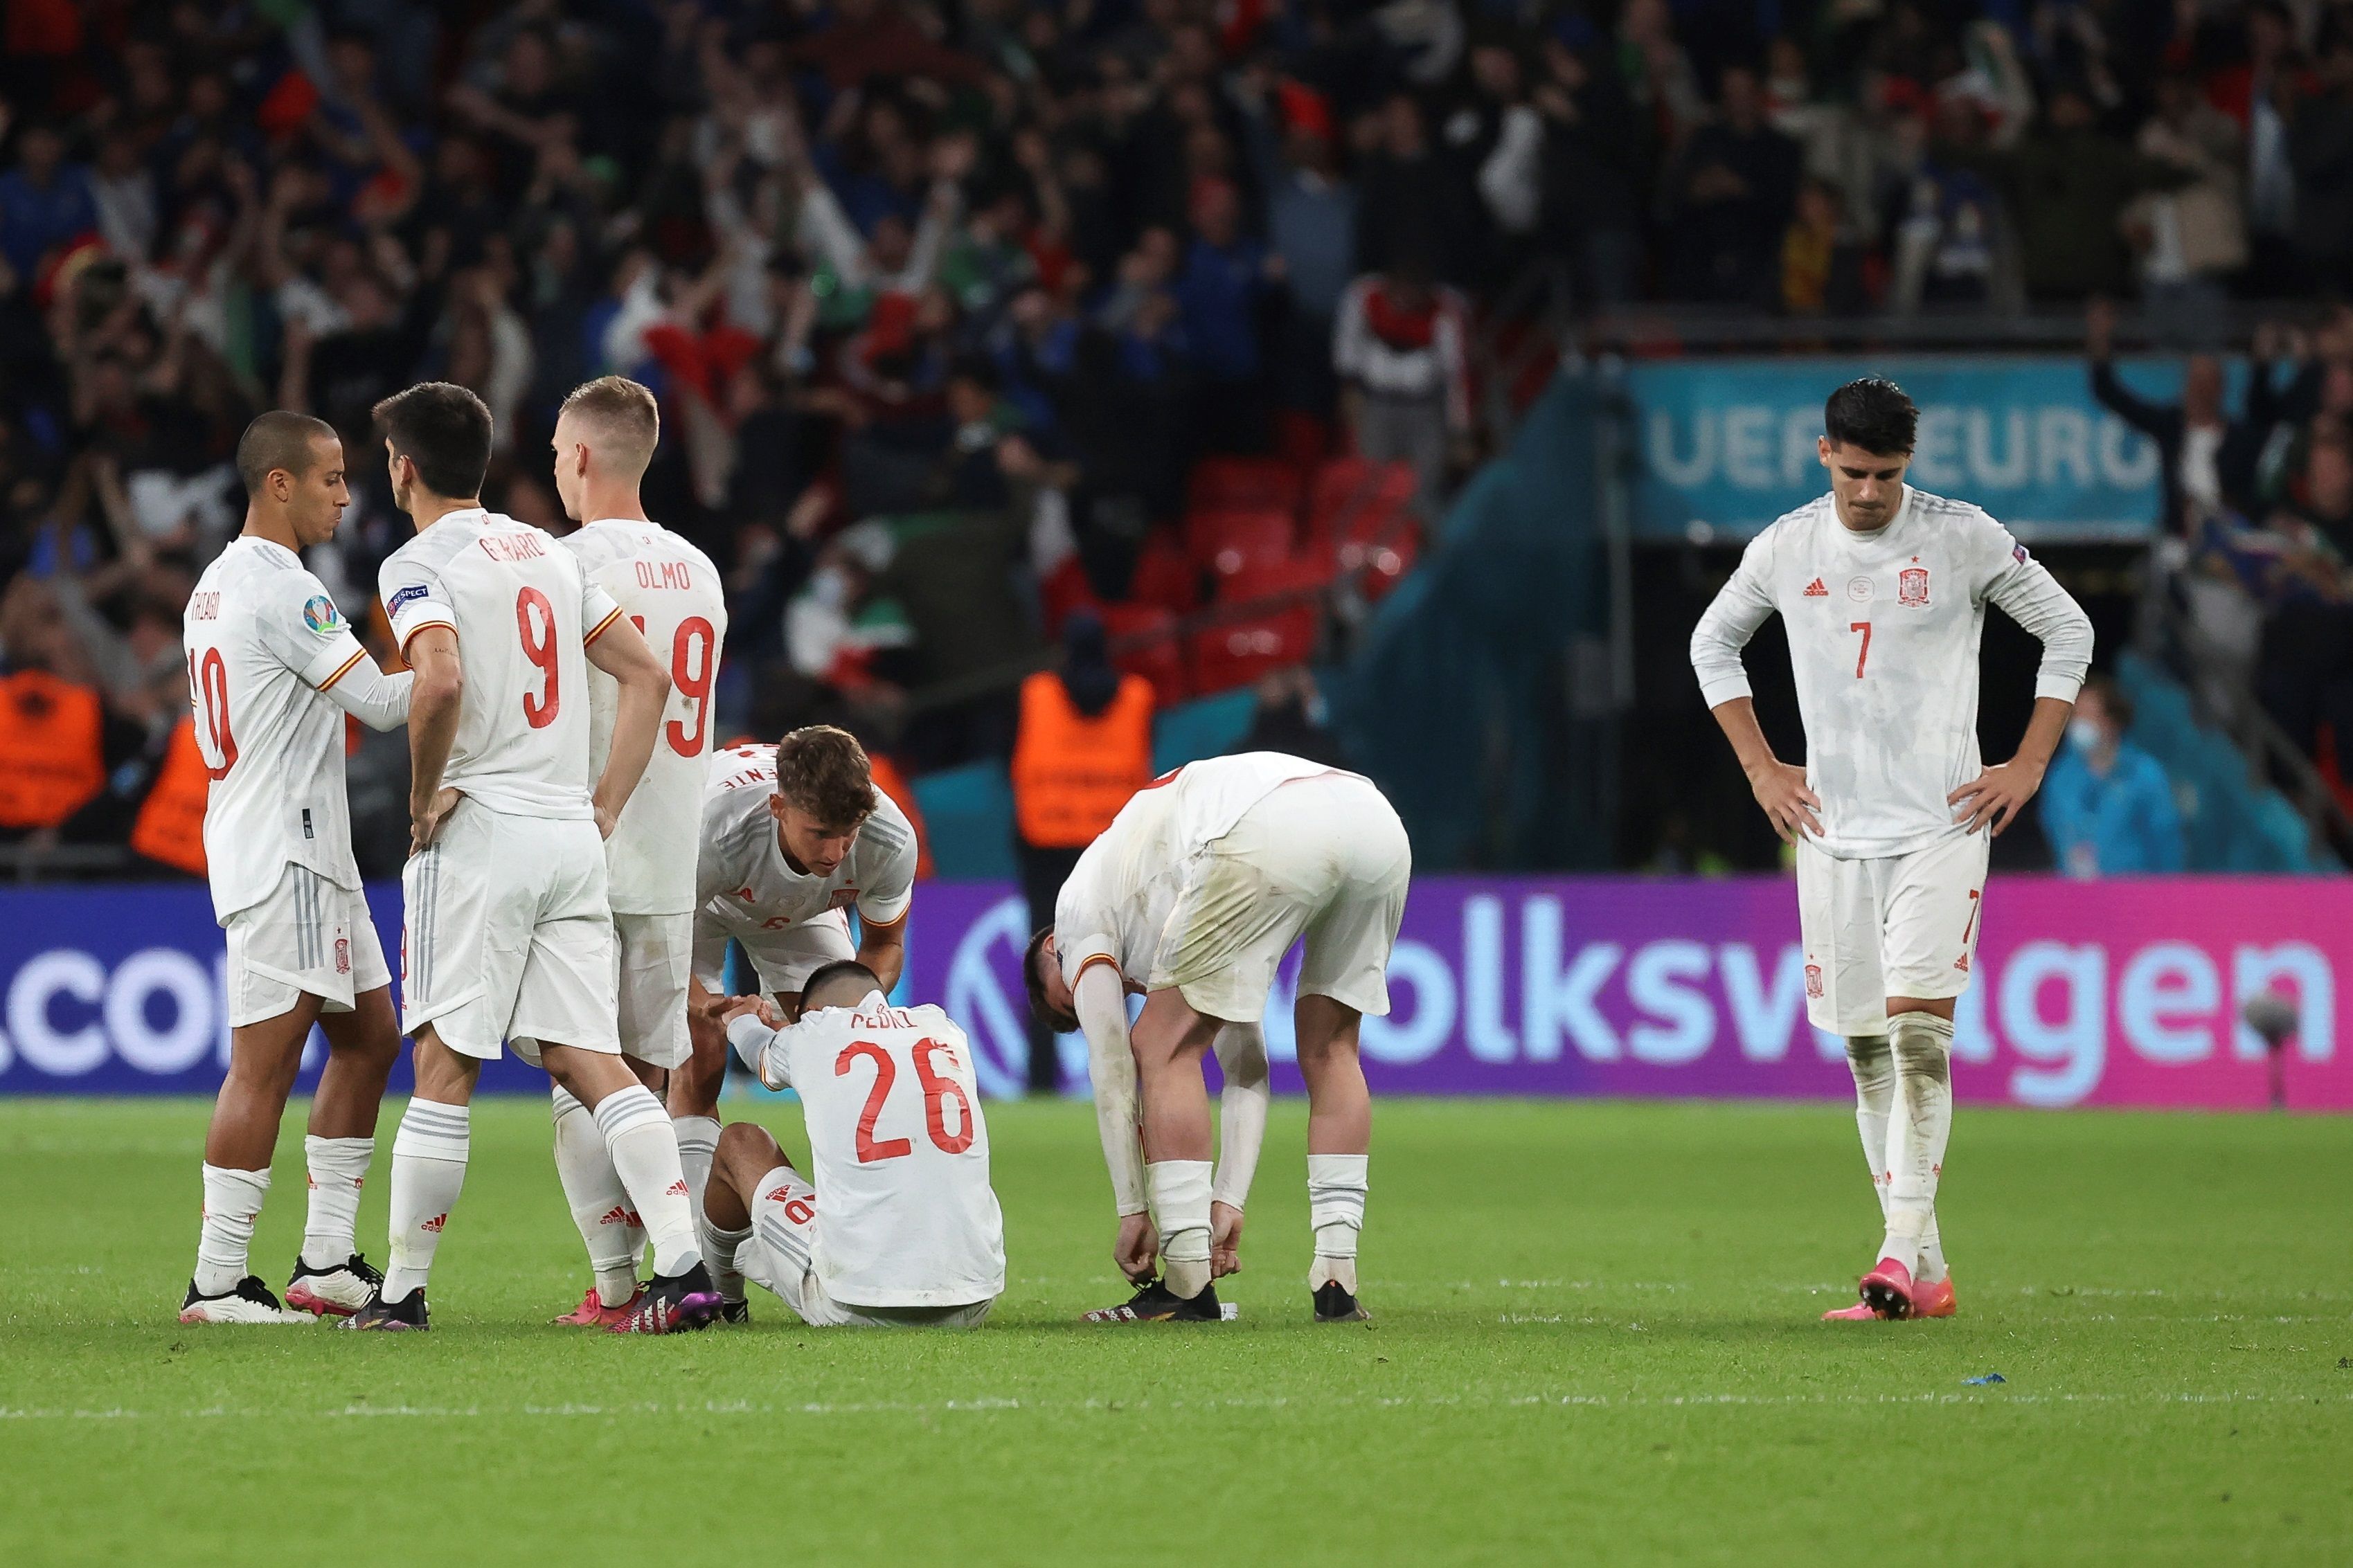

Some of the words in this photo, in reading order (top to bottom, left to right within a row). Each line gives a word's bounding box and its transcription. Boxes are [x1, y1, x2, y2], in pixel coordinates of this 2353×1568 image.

[1645, 407, 1828, 489] UEF
[191, 591, 220, 620] THIAGO
[393, 588, 427, 606] RESPECT
[635, 561, 690, 590] OLMO
[517, 586, 560, 728] 9
[1851, 622, 1871, 678] 7
[631, 615, 715, 757] 9
[1962, 889, 1979, 944] 7
[1262, 894, 2336, 1108] olkswgen
[834, 1037, 974, 1164] 26
